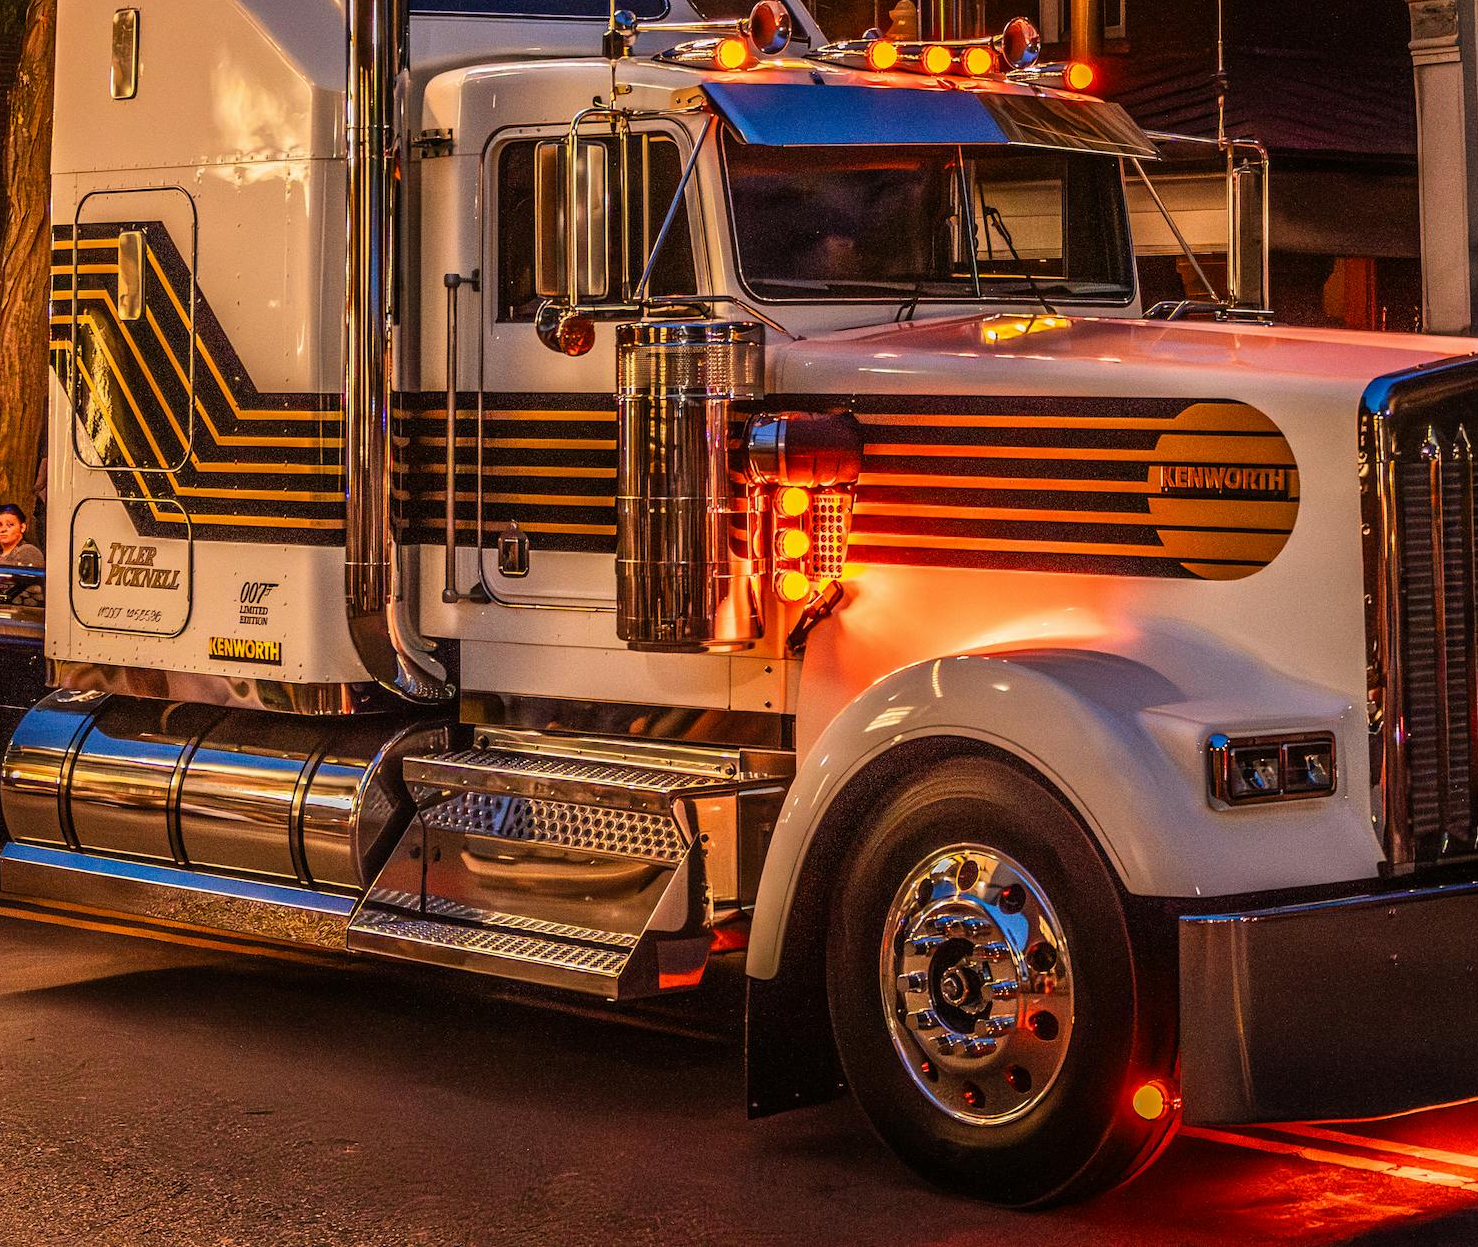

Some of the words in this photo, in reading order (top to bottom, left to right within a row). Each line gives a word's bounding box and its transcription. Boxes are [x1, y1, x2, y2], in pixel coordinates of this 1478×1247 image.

[1160, 465, 1287, 491] KENWORTH
[107, 542, 157, 567] TYLER
[105, 563, 181, 590] PICKNELL
[240, 581, 274, 604] 007
[240, 605, 269, 615] LIMITED
[240, 615, 269, 625] EDITION
[209, 637, 281, 662] KENWORTH
